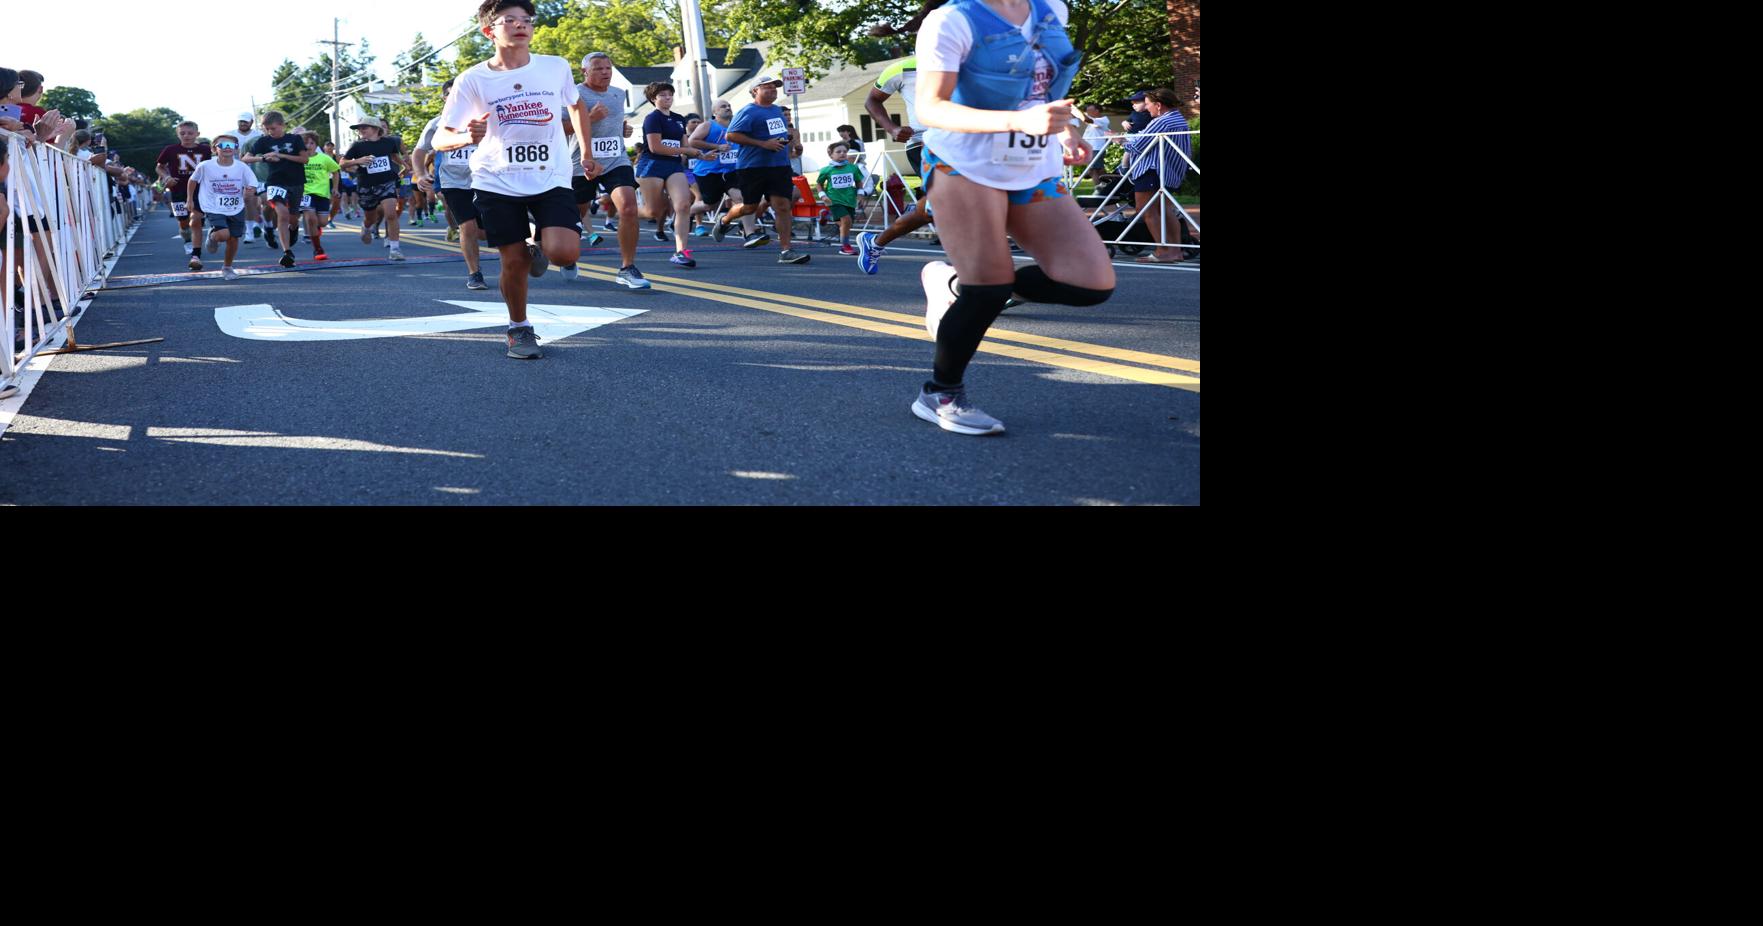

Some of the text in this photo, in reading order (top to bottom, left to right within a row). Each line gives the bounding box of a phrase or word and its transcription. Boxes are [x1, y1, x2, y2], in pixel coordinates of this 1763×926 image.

[504, 101, 543, 113] Yankee
[497, 108, 551, 122] Homecoming
[593, 140, 619, 152] 1023
[506, 144, 549, 163] 1868
[368, 158, 388, 169] 2528
[832, 175, 852, 185] 2295
[219, 197, 239, 206] 1236
